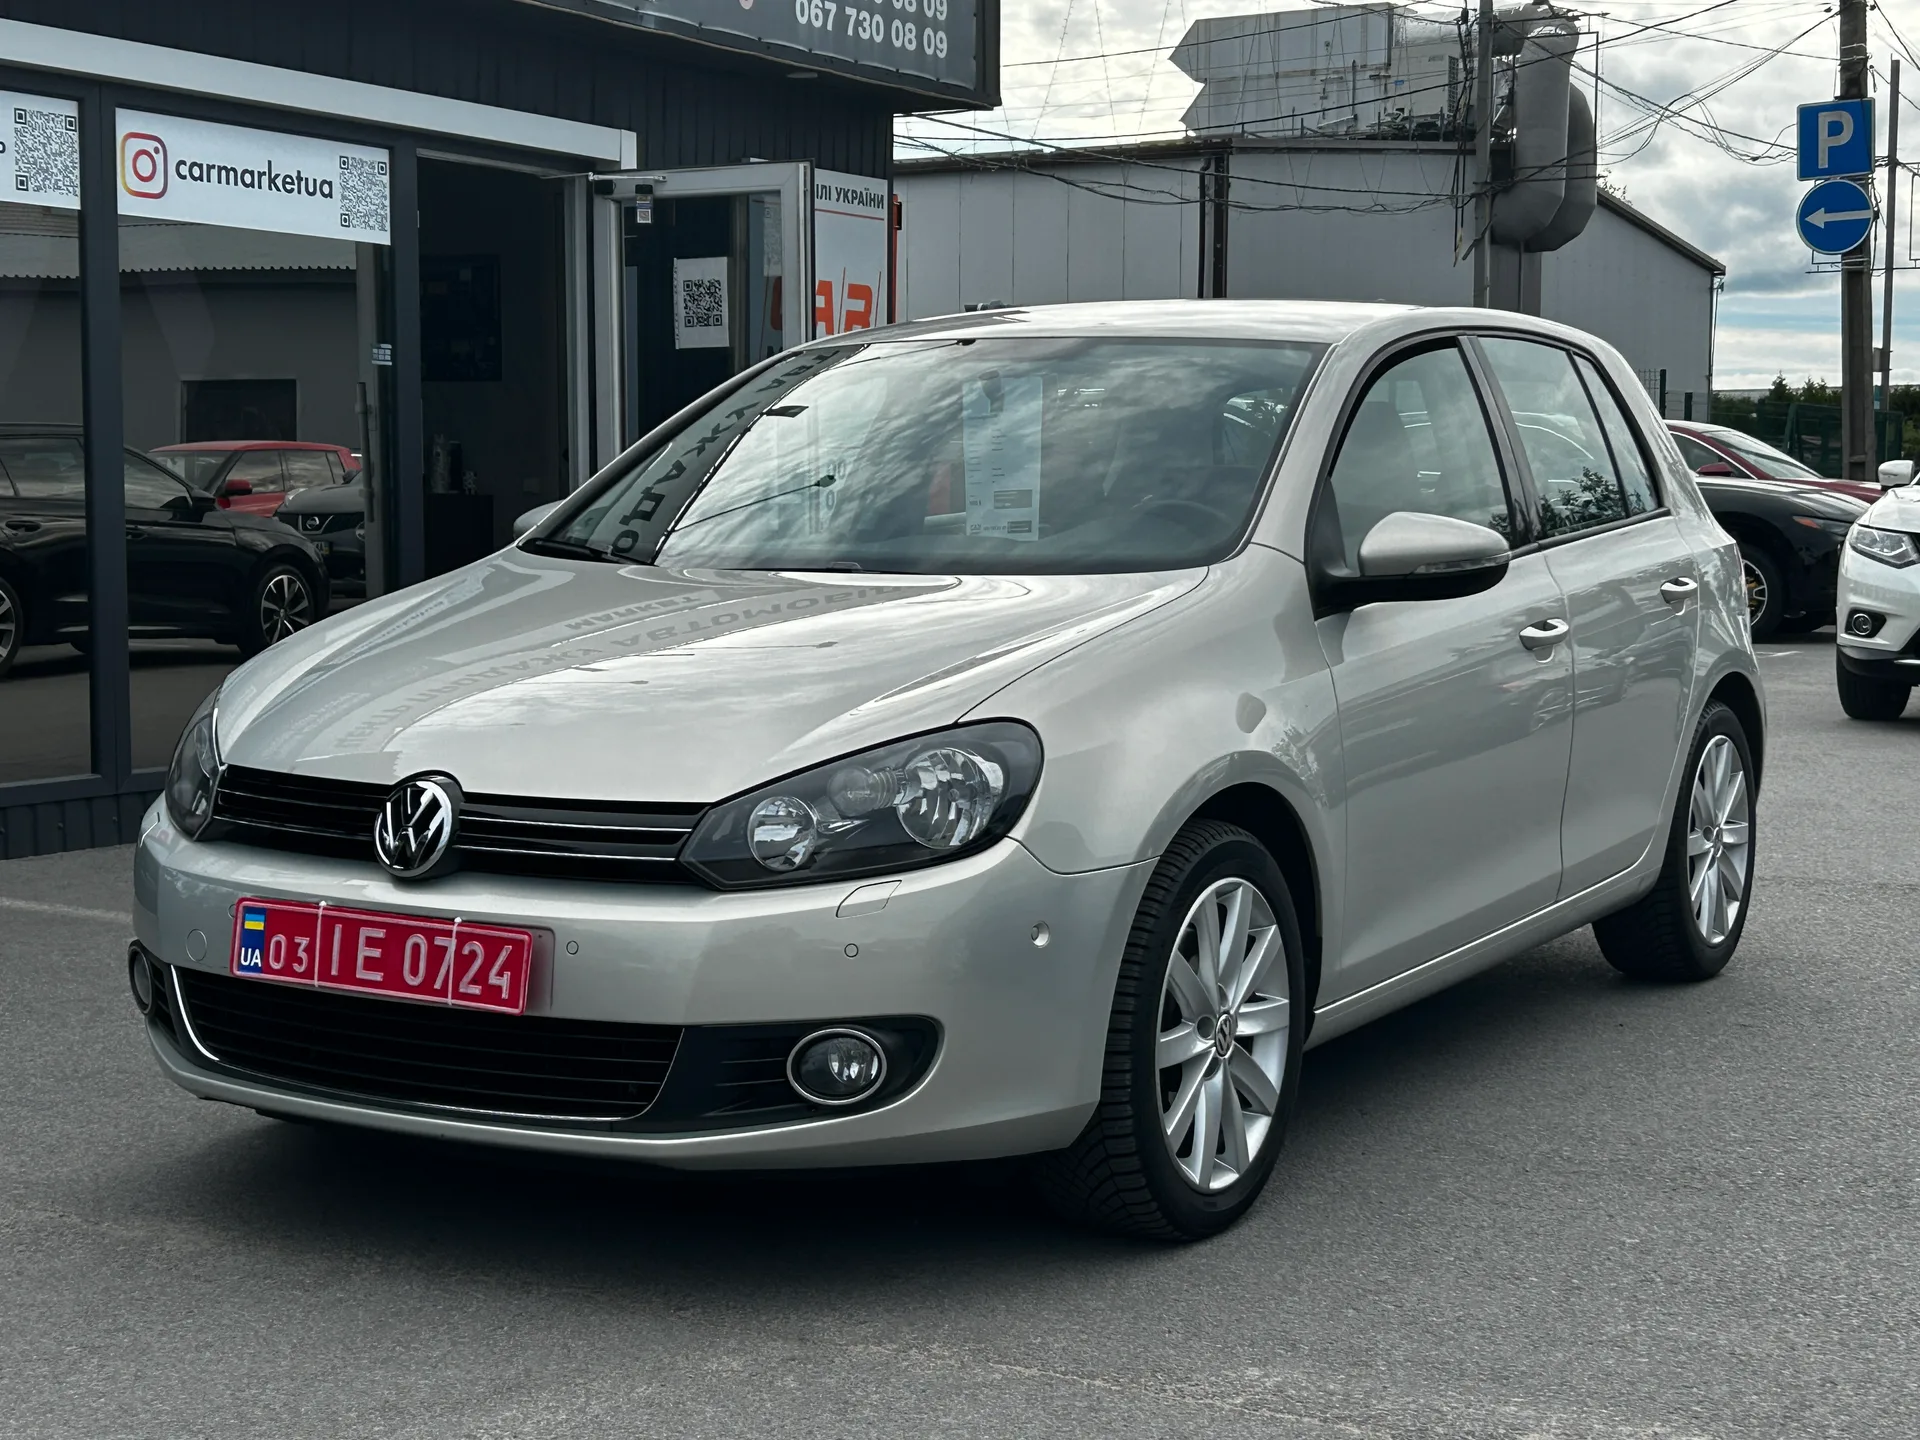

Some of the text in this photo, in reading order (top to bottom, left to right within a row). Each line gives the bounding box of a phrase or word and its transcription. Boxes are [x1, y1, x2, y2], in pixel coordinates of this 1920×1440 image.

[796, 0, 836, 31] 067
[845, 6, 884, 43] 730
[891, 19, 917, 51] 08
[923, 27, 948, 59] 09
[1818, 110, 1854, 169] P
[175, 160, 333, 199] carmarketua
[835, 187, 884, 210] УКРАЇНИ
[240, 947, 262, 968] UA
[269, 923, 512, 999] 03 IE 0724
